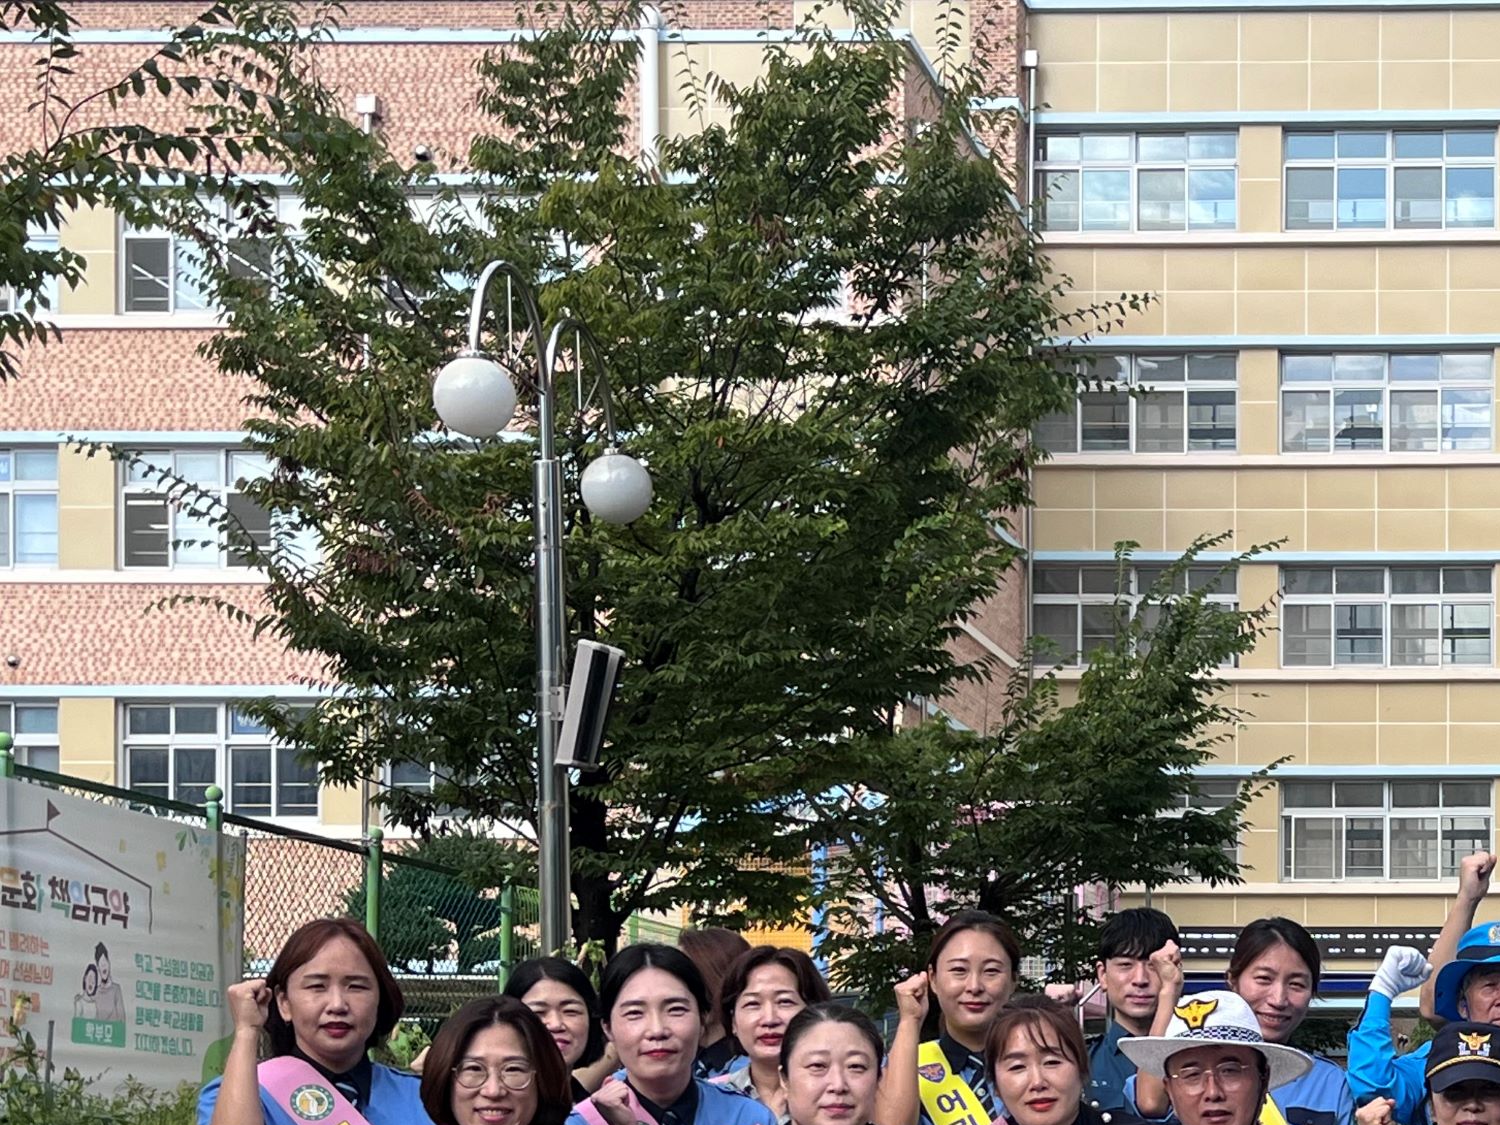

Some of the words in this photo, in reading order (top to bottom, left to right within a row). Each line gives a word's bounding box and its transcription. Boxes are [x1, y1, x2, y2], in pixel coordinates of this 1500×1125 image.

[48, 876, 130, 929] 책임규약
[155, 956, 188, 978] 구성원의
[136, 980, 161, 1001] 의견을
[85, 1021, 113, 1044] 학부모
